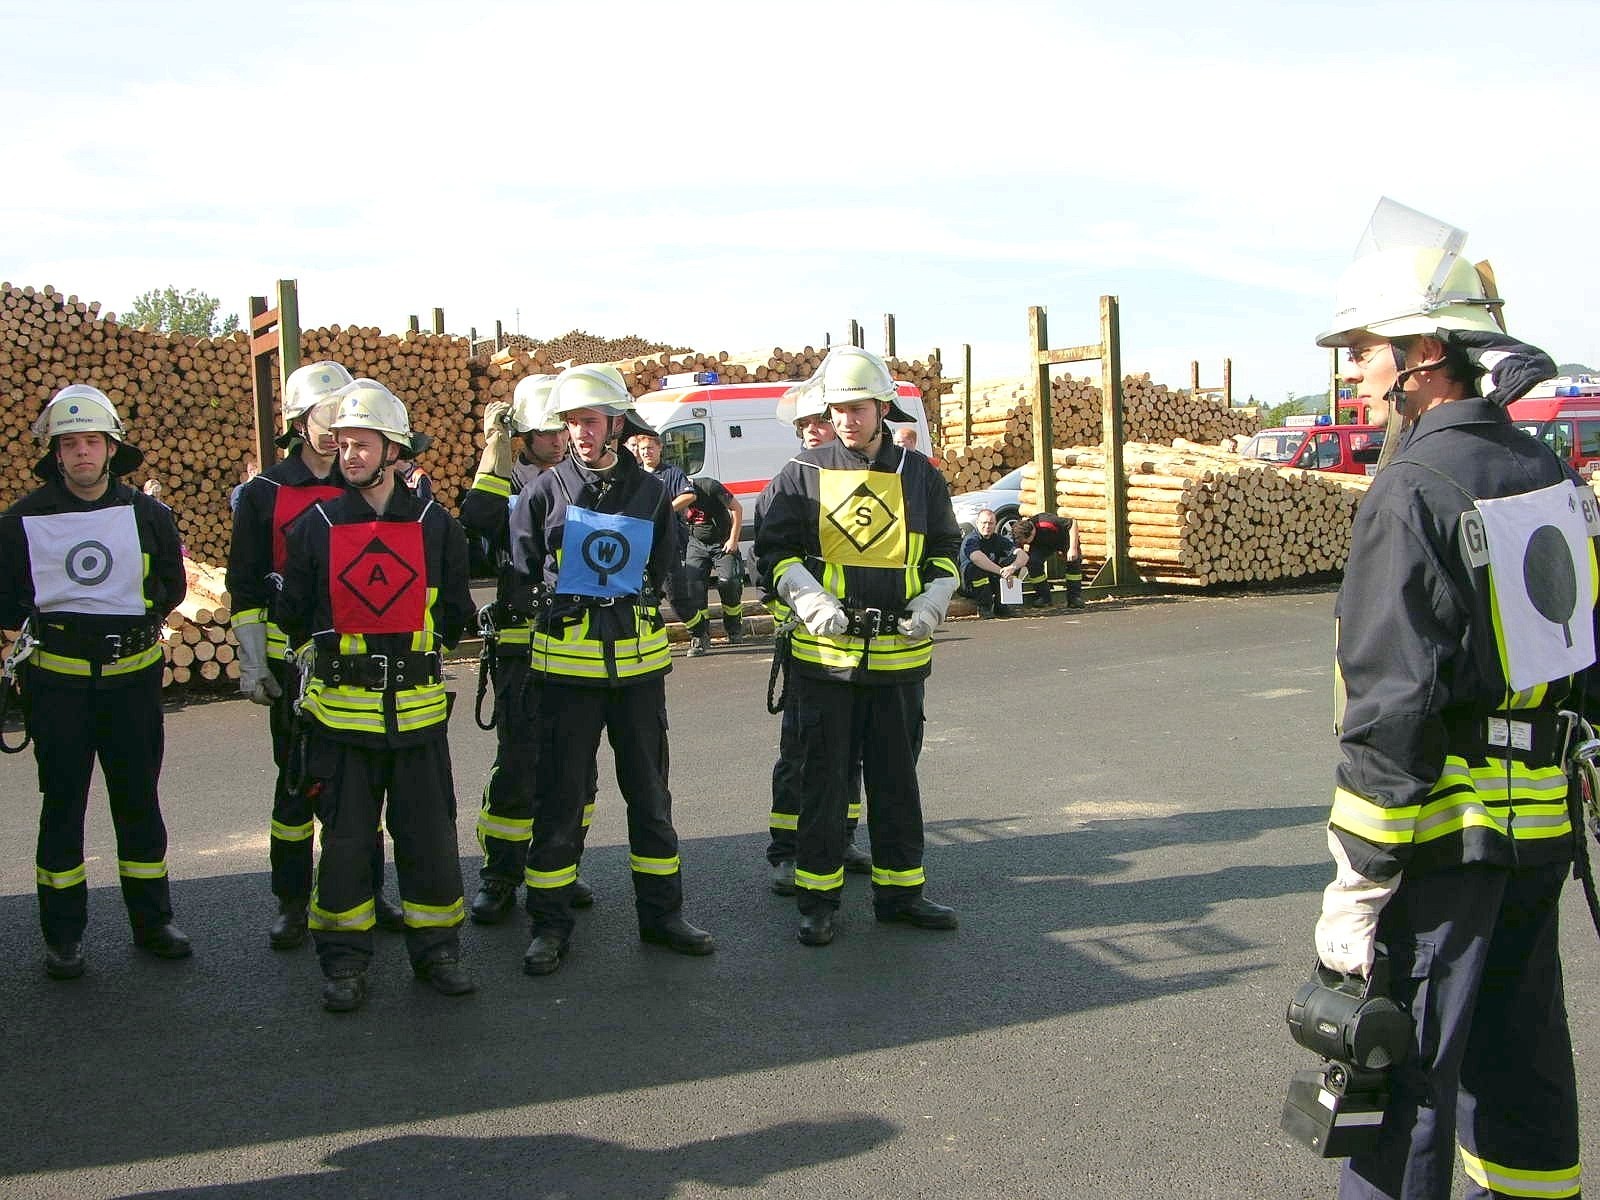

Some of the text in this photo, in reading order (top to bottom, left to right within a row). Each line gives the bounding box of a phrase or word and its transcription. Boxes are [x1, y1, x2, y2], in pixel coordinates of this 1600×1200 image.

[855, 506, 872, 527] S
[598, 541, 617, 563] W
[367, 563, 389, 586] A
